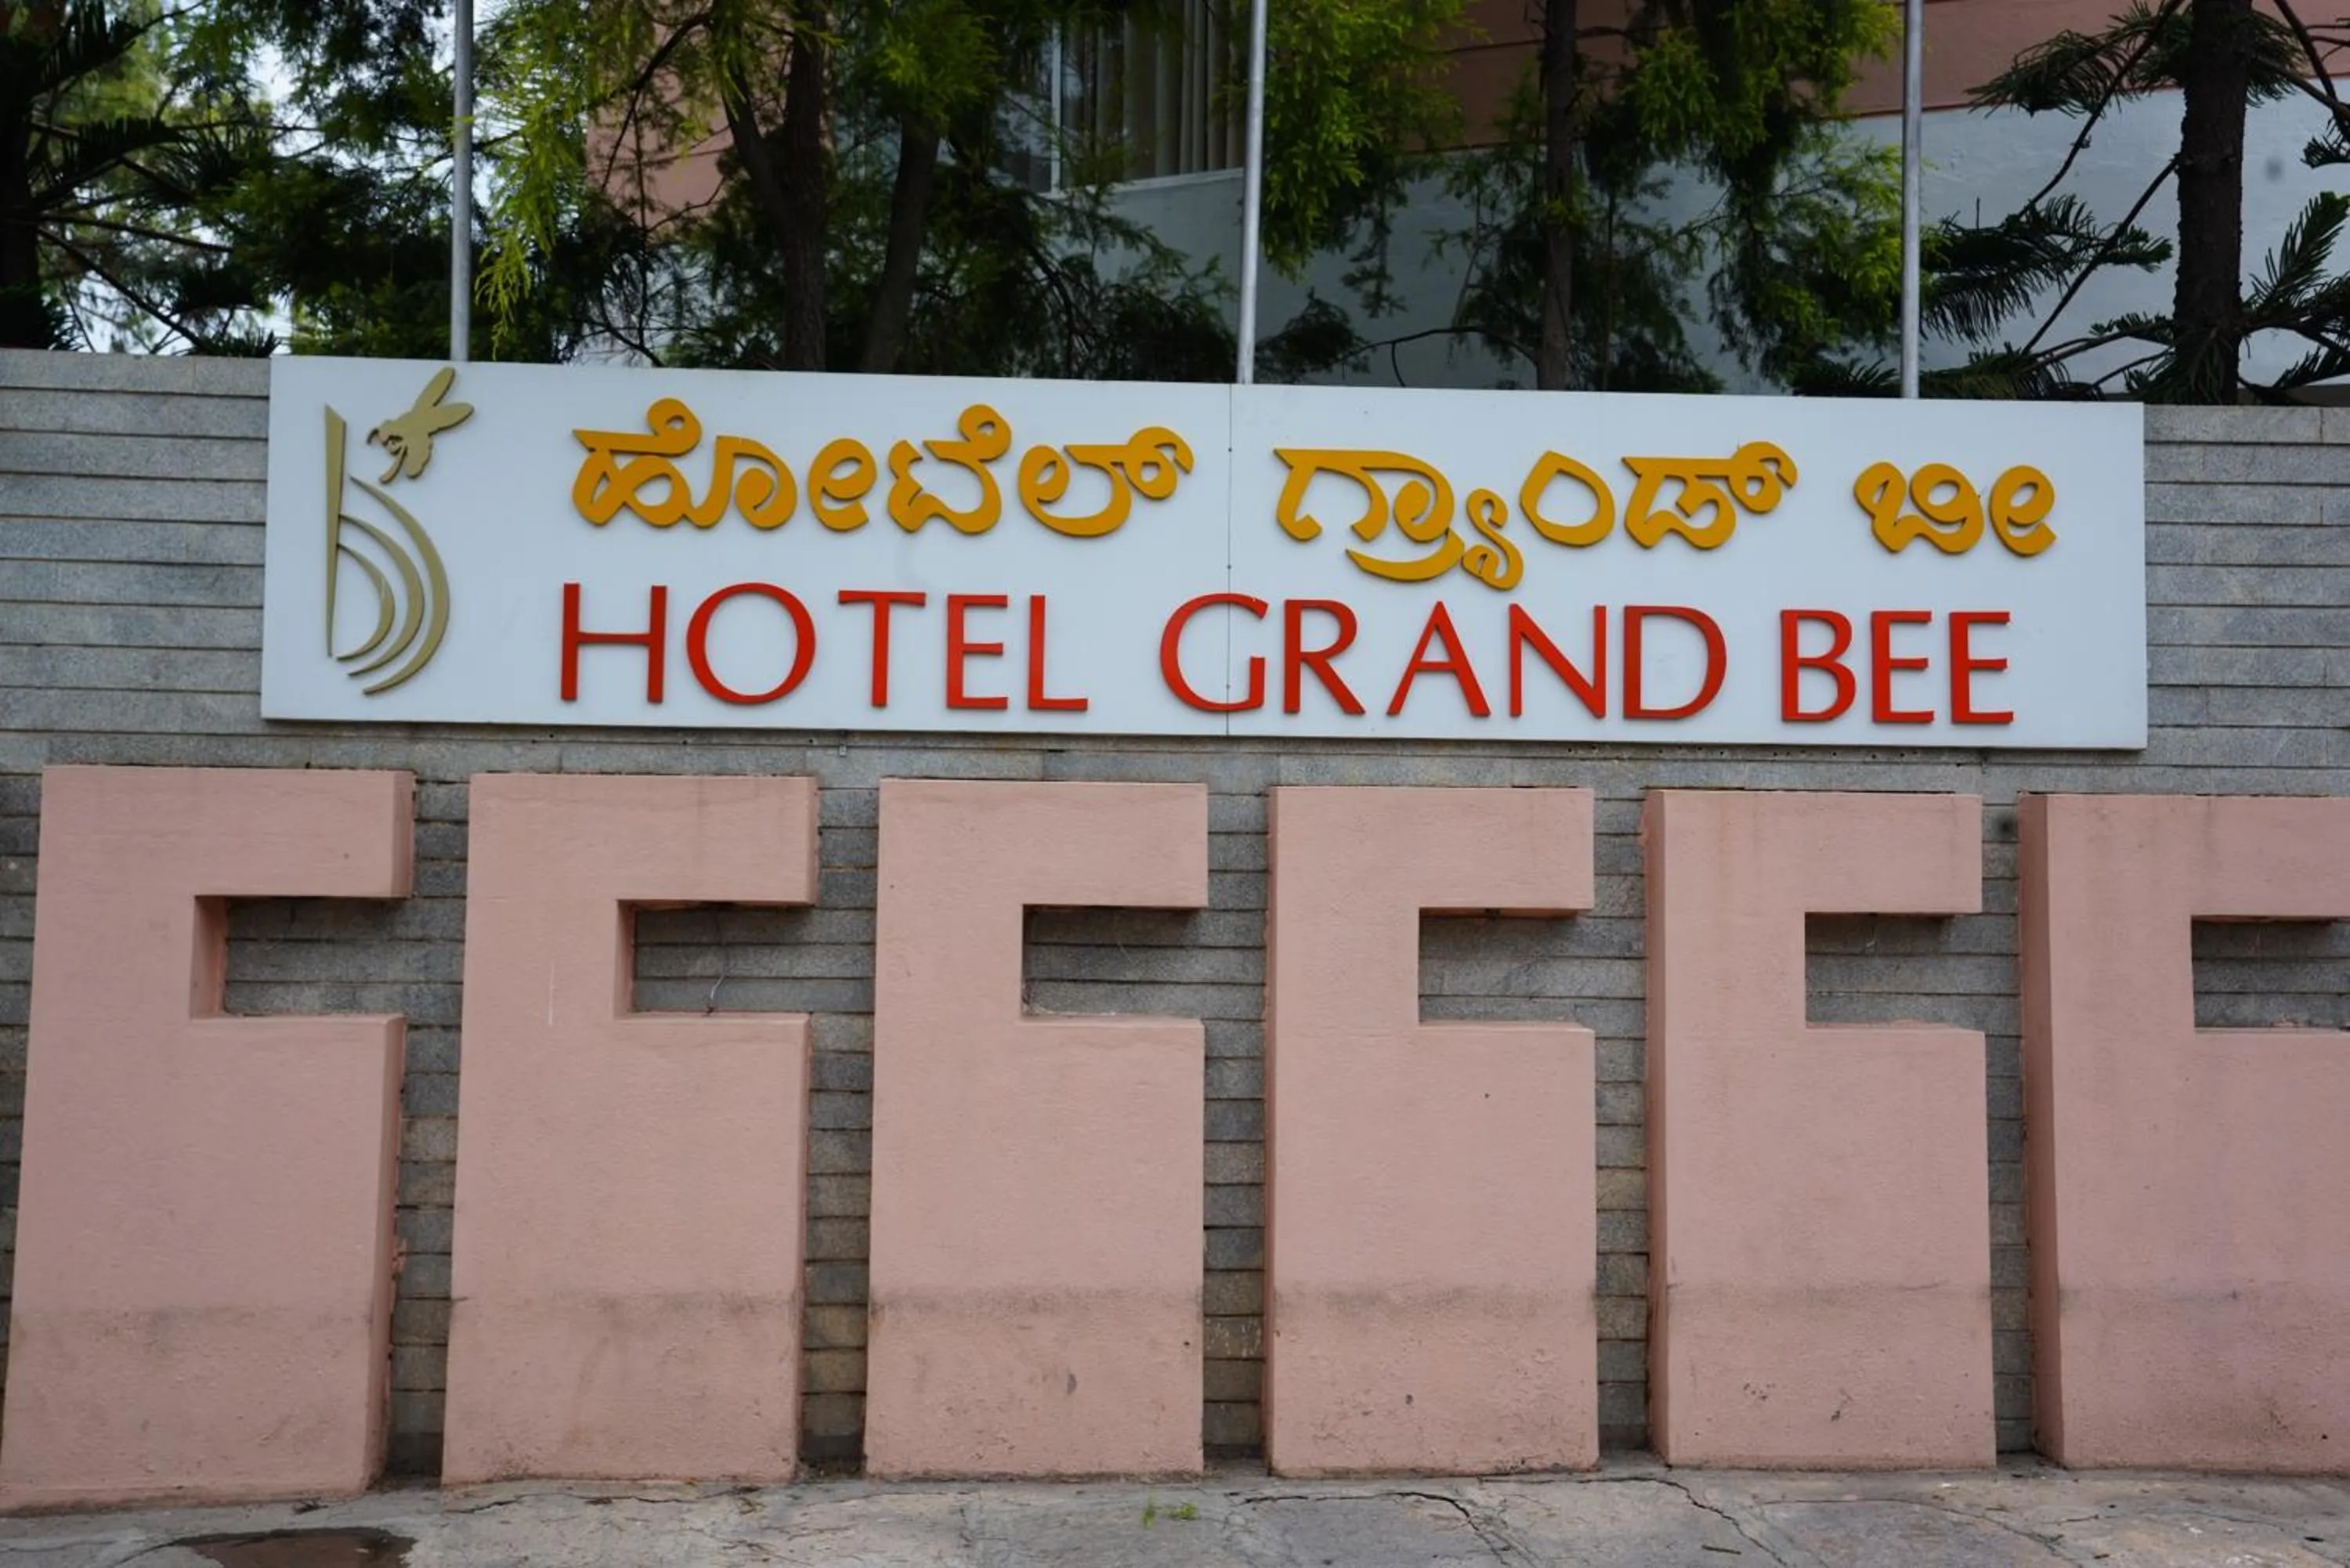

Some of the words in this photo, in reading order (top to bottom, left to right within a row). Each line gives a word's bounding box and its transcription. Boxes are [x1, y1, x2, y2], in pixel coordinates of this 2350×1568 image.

[573, 398, 1195, 538] ಹೋಟೆಲ್
[1853, 462, 2057, 558] ಬೀ
[561, 583, 1089, 711] HOTEL
[1160, 593, 1727, 720] GRAND
[1781, 609, 2014, 724] BEE
